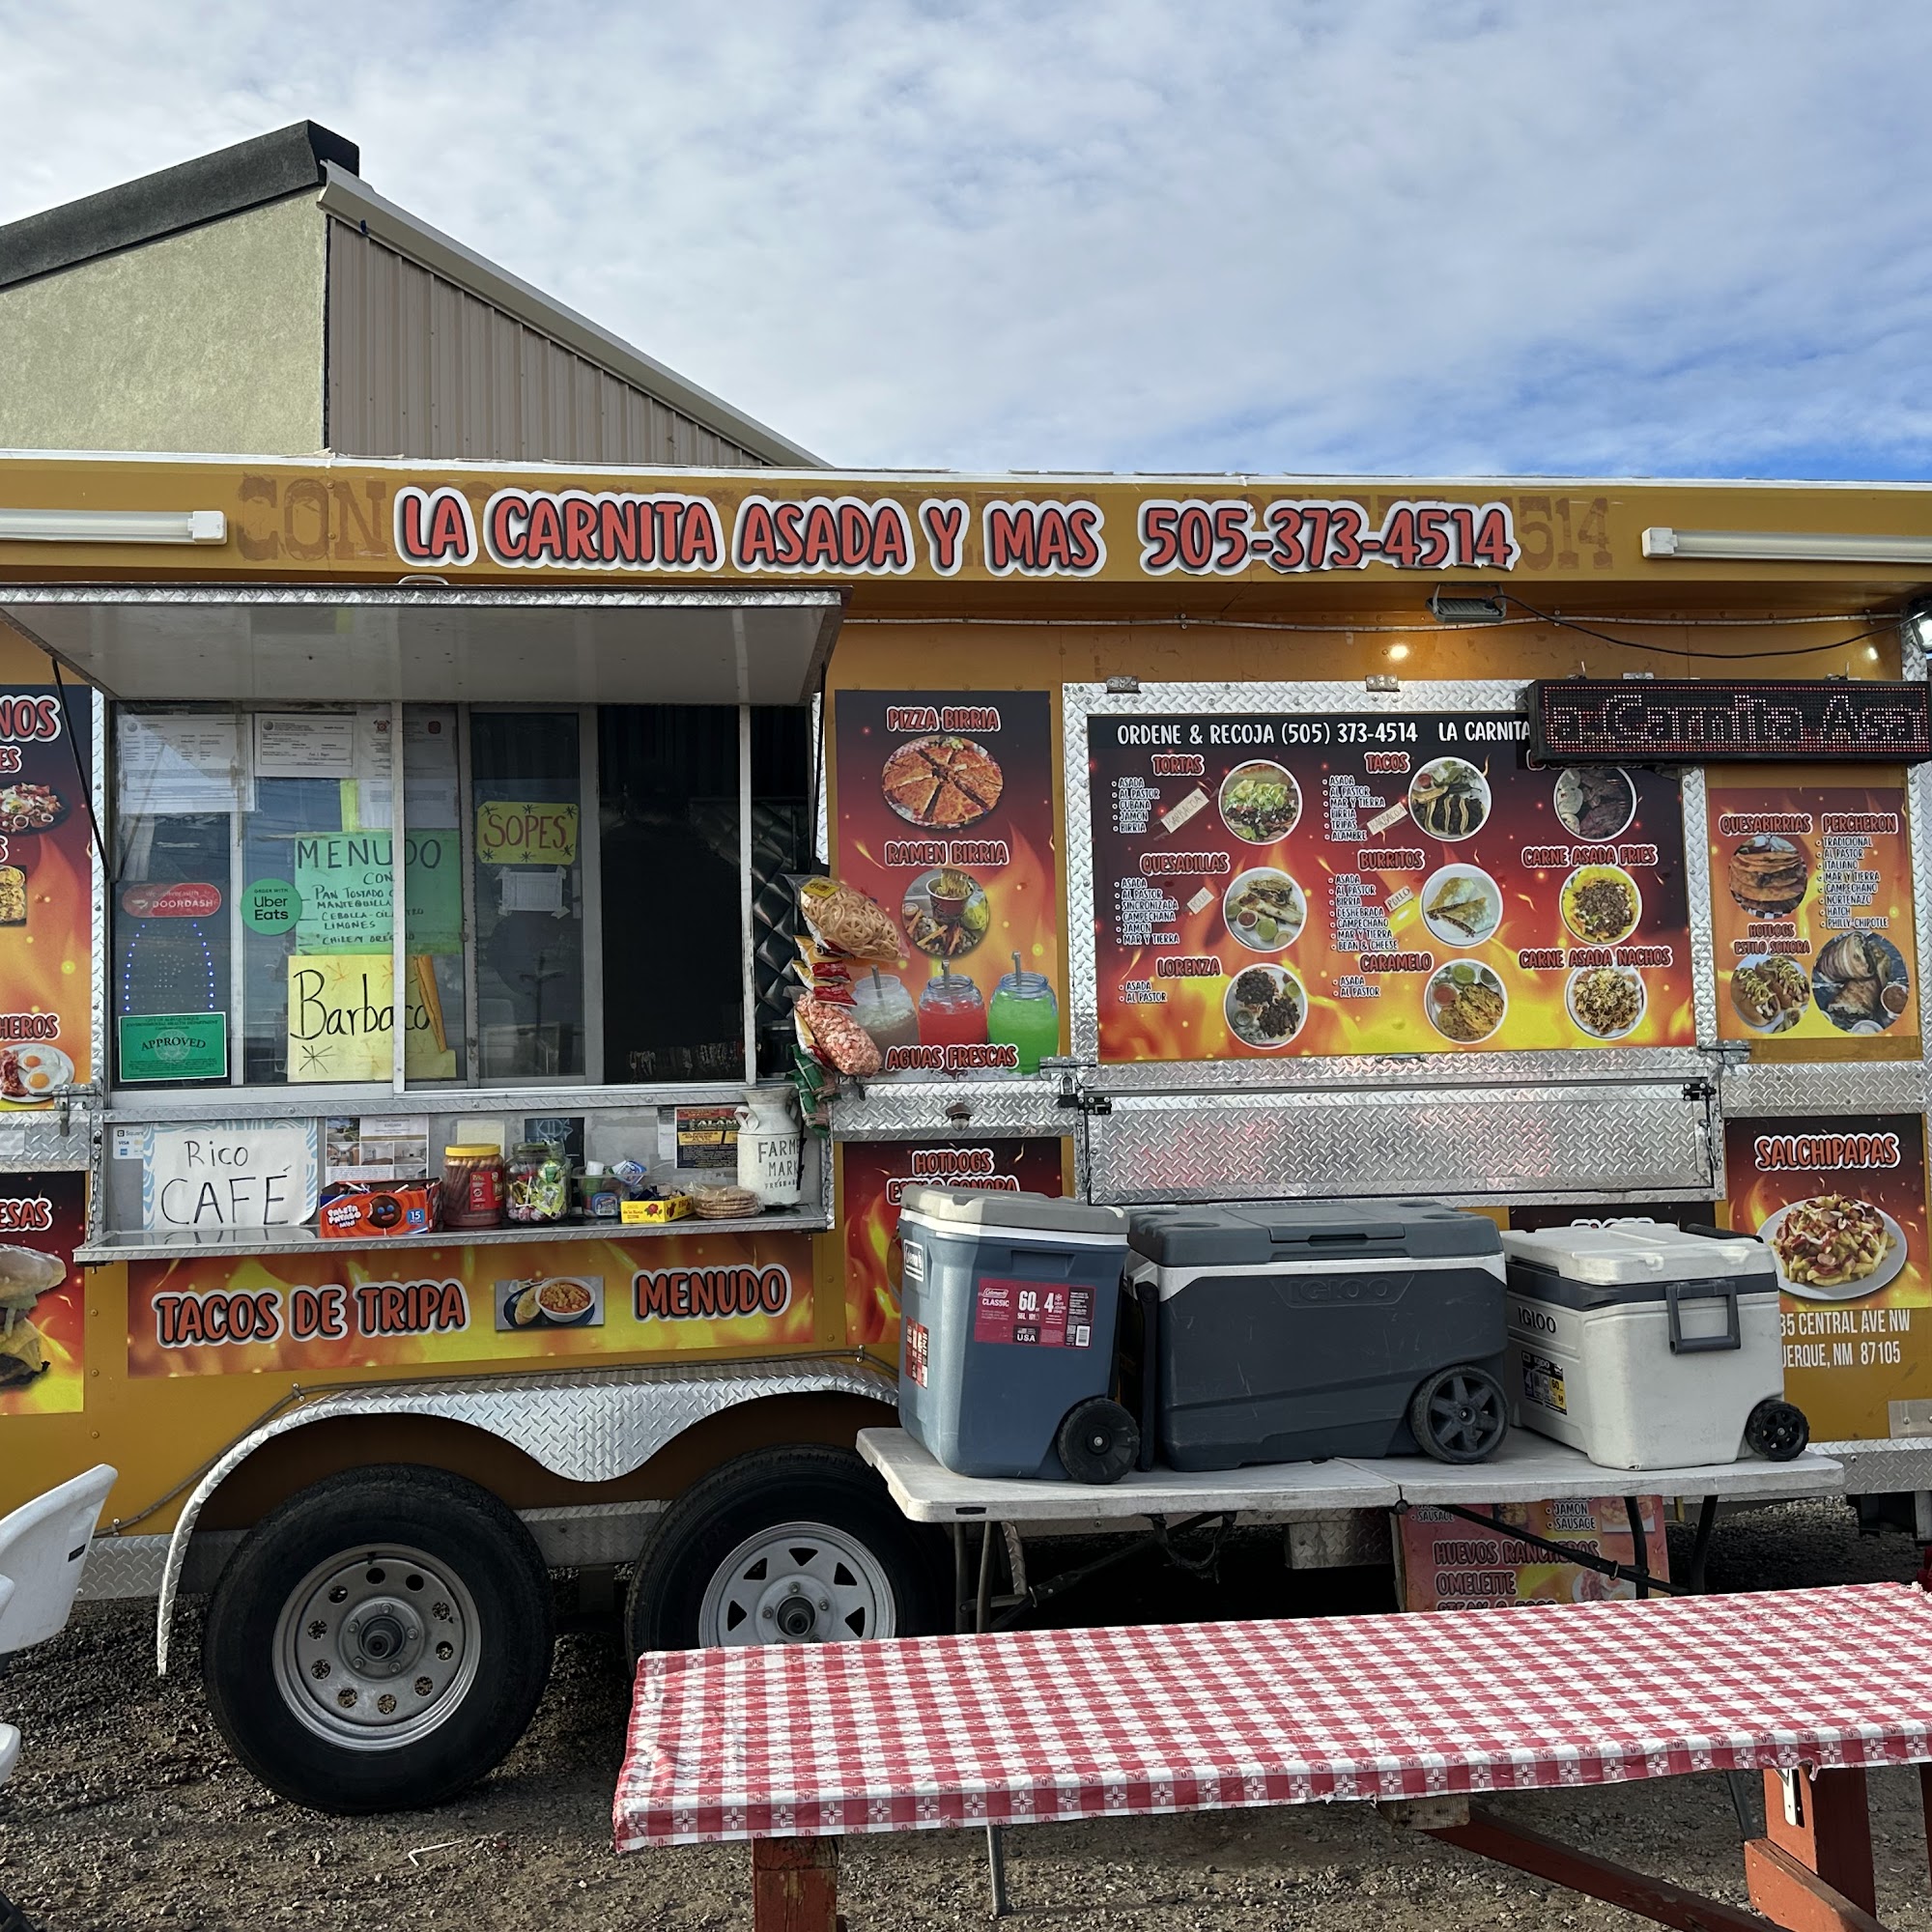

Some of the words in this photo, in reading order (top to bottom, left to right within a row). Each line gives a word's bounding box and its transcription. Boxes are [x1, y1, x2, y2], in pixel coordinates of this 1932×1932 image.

[399, 491, 472, 561] LA
[491, 491, 721, 564] CARNITA
[738, 497, 910, 570] ASADA
[924, 503, 965, 570] Y
[990, 504, 1100, 571] MAS
[1145, 503, 1515, 570] 505-373-4514
[887, 707, 939, 730] PIZZA
[943, 707, 1000, 730] BIRRIA
[1604, 694, 1804, 741] Carnita
[1117, 724, 1182, 745] ORDENE
[1189, 724, 1204, 744] &
[1209, 723, 1275, 745] RECOJA
[1281, 722, 1331, 745] (505)
[1337, 722, 1419, 743] 373-4514
[1438, 722, 1458, 742] LA
[1464, 721, 1531, 742] CARNITA
[1152, 755, 1205, 774] TORTAS
[1366, 754, 1409, 773] TACOS
[1119, 778, 1145, 788] ASADA
[1329, 776, 1355, 786] ASADA
[1119, 788, 1129, 800] AL
[1131, 788, 1160, 800] PASTOR
[1329, 786, 1340, 797] AL
[1341, 785, 1371, 797] PASTOR
[1119, 800, 1151, 810] CUBANA
[1329, 797, 1349, 809] MAR
[1350, 798, 1356, 808] Y
[1358, 797, 1385, 809] TIERRA
[1330, 809, 1356, 819] BIRRIA
[1120, 822, 1148, 834] BIRRIA
[1330, 819, 1357, 831] TRIPAS
[1719, 814, 1812, 835] QUESABIRRIAS
[1822, 814, 1897, 834] PERCHERON
[484, 815, 568, 849] SOPES
[1331, 830, 1367, 841] ALAMBRE
[1823, 837, 1872, 847] TRADICIONAL
[886, 842, 947, 865] RAMEN
[952, 842, 1009, 865] BIRRIA
[1358, 851, 1424, 869] BURRITOS
[1523, 847, 1567, 867] CARNE
[1572, 847, 1616, 867] ASADA
[1620, 845, 1658, 866] FRIES
[1824, 848, 1834, 859] AL
[1836, 848, 1863, 859] PASTOR
[1142, 854, 1229, 875] QUESADILLAS
[1824, 860, 1859, 870] ITALIANO
[1121, 878, 1148, 889] ASADA
[1335, 874, 1361, 885] ASADA
[1825, 872, 1843, 883] MAR
[1845, 872, 1852, 882] Y
[1853, 871, 1881, 882] TIERRA
[313, 885, 338, 899] PAN
[343, 887, 384, 899] TOSTADO
[1121, 889, 1132, 900] AL
[1133, 888, 1163, 899] PASTOR
[1335, 885, 1346, 896] AL
[1348, 885, 1376, 895] PASTOR
[1826, 883, 1877, 895] CAMPECHANO
[152, 898, 213, 909] DOORDASH
[254, 895, 289, 908] Uber
[1122, 899, 1179, 911] SINCRONIZADA
[1336, 896, 1362, 907] BIRRIA
[1386, 887, 1411, 910] POLLO
[254, 908, 290, 921] Eats
[1122, 911, 1176, 922] CAMPECHANA
[1336, 907, 1384, 918] DESHEBRADA
[1827, 906, 1851, 917] HATCH
[324, 921, 376, 930] LIMONES
[1337, 918, 1389, 929] CAMPECHANO
[1337, 929, 1355, 941] MAR
[1357, 929, 1364, 940] Y
[1366, 929, 1393, 940] TIERRA
[1747, 923, 1796, 938] HOTDOGS
[1122, 934, 1142, 945] MAR
[1144, 934, 1151, 945] Y
[1151, 933, 1179, 945] TIERRA
[1337, 941, 1359, 952] BEAN
[1360, 941, 1368, 952] &
[1370, 940, 1399, 951] CHEESE
[1734, 941, 1768, 954] ESTILO
[1770, 941, 1811, 954] SONORA
[1359, 952, 1433, 972] CARAMELO
[1520, 949, 1564, 968] CARNE
[1569, 948, 1612, 966] ASADA
[1617, 947, 1672, 965] NACHOS
[1157, 957, 1222, 978] LORENZA
[1125, 980, 1152, 992] ASADA
[1339, 975, 1366, 985] ASADA
[1125, 992, 1137, 1004] AL
[1138, 991, 1167, 1003] PASTOR
[1340, 987, 1350, 998] AL
[1352, 986, 1380, 997] PASTOR
[141, 1036, 207, 1052] APPROVED
[887, 1046, 943, 1070] AGUAS
[948, 1045, 1018, 1069] FRESCAS
[184, 1140, 249, 1168] Rico
[1756, 1136, 1899, 1168] SALCHIPAPAS
[914, 1151, 992, 1175] HOTDOGS
[160, 1164, 293, 1226] CAFÉ
[410, 1210, 421, 1219] 15
[636, 1266, 789, 1319] MENUDO
[1289, 1277, 1393, 1303] IGLOO
[981, 1298, 1010, 1308] CLASSIC
[1018, 1290, 1037, 1312] 60
[1043, 1293, 1055, 1314] 4
[156, 1293, 281, 1345] TACOS
[293, 1290, 345, 1338] DE
[358, 1282, 467, 1333] TRIPA
[1518, 1306, 1557, 1334] IGLOO
[1798, 1311, 1858, 1336] CENTRAL
[1861, 1310, 1886, 1333] AVE
[1889, 1309, 1911, 1332] NW
[1833, 1343, 1853, 1366] NM
[1861, 1341, 1901, 1365] 87105
[1553, 1501, 1589, 1517] JAMON
[1554, 1517, 1597, 1531] SAUSAGE
[1434, 1542, 1498, 1566] HUEVOS
[1436, 1572, 1517, 1596] OMELETTE
